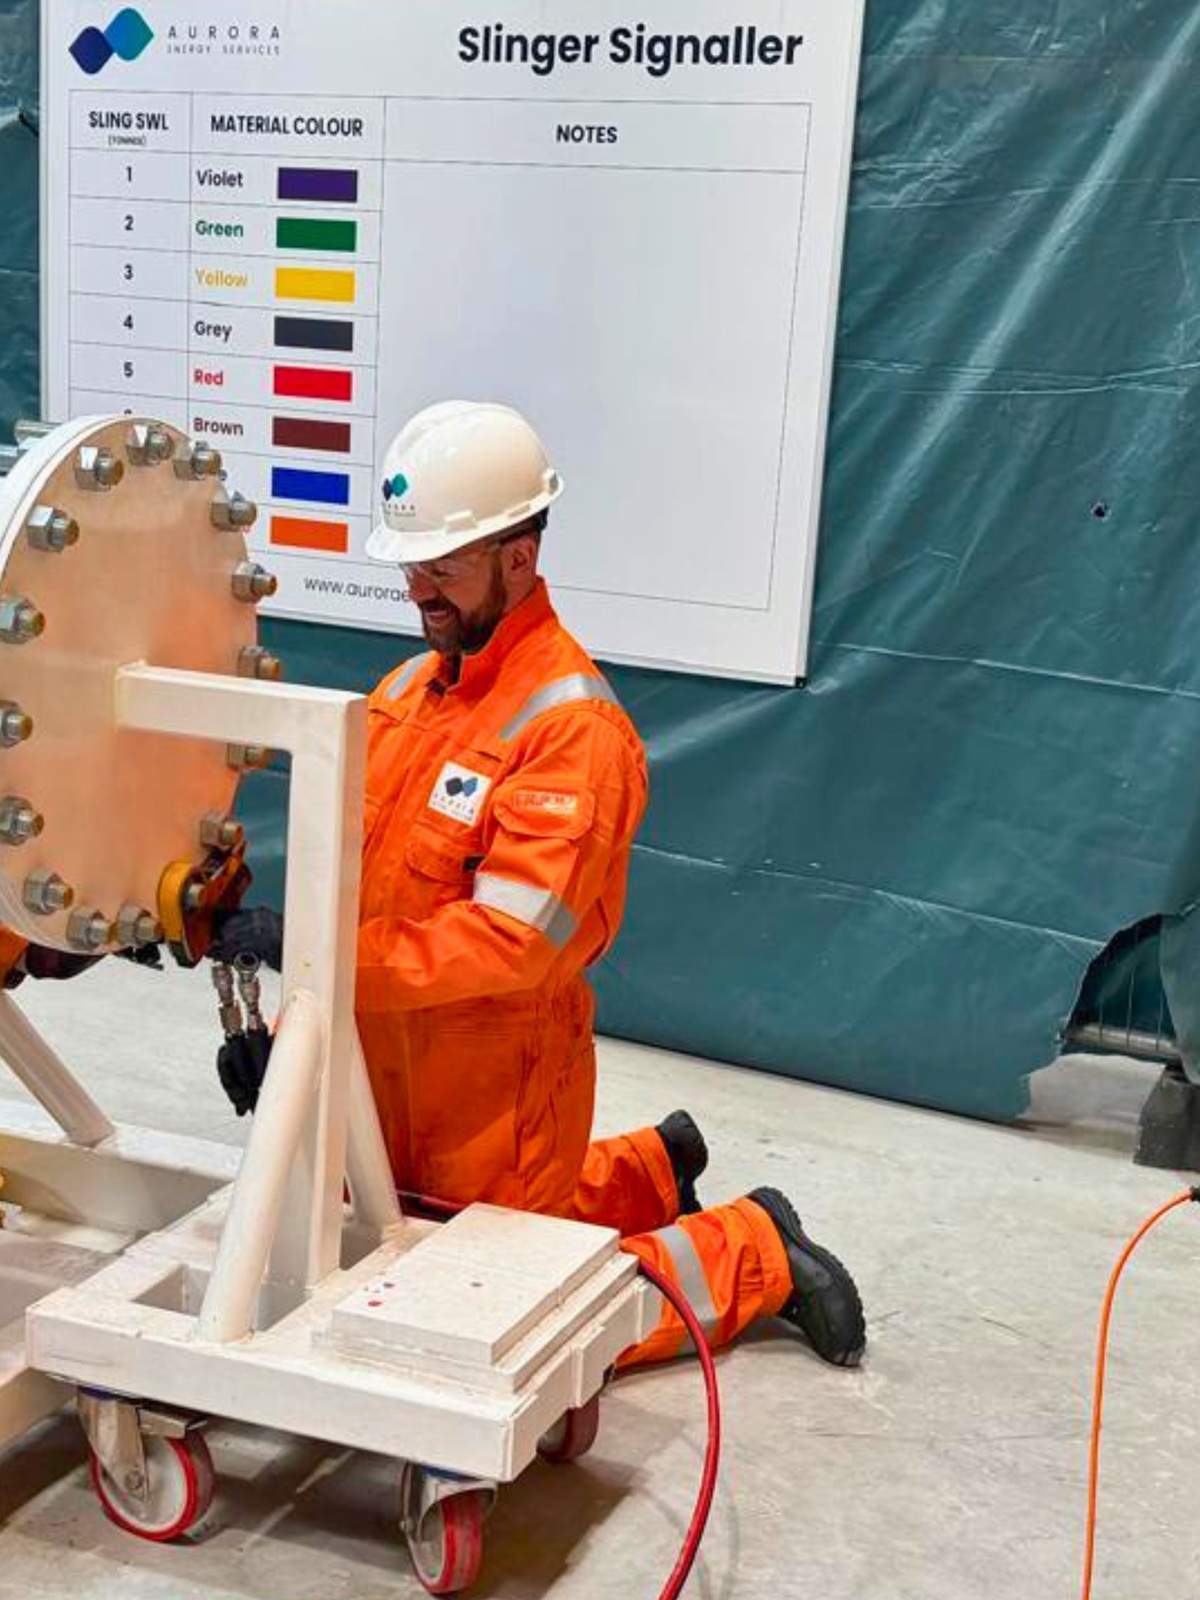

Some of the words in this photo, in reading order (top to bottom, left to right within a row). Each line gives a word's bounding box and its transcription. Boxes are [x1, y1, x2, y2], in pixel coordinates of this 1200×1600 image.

[168, 25, 280, 39] AURORA
[458, 23, 600, 76] Slinger
[609, 23, 804, 77] Signaller
[88, 110, 132, 128] SLING
[135, 111, 169, 130] SWL
[210, 114, 290, 135] MATERIAL
[293, 117, 363, 137] COLOUR
[556, 124, 618, 143] NOTES
[125, 166, 133, 182] 1
[195, 168, 244, 187] Violet
[124, 215, 134, 231] 2
[195, 220, 244, 237] Green
[123, 263, 134, 281] 3
[195, 268, 249, 287] Yellow
[122, 314, 134, 330] 4
[194, 320, 232, 343] Grey
[123, 361, 134, 378] 5
[193, 369, 224, 386] Red
[193, 417, 244, 436] Brown
[303, 577, 409, 603] www.aurorae
